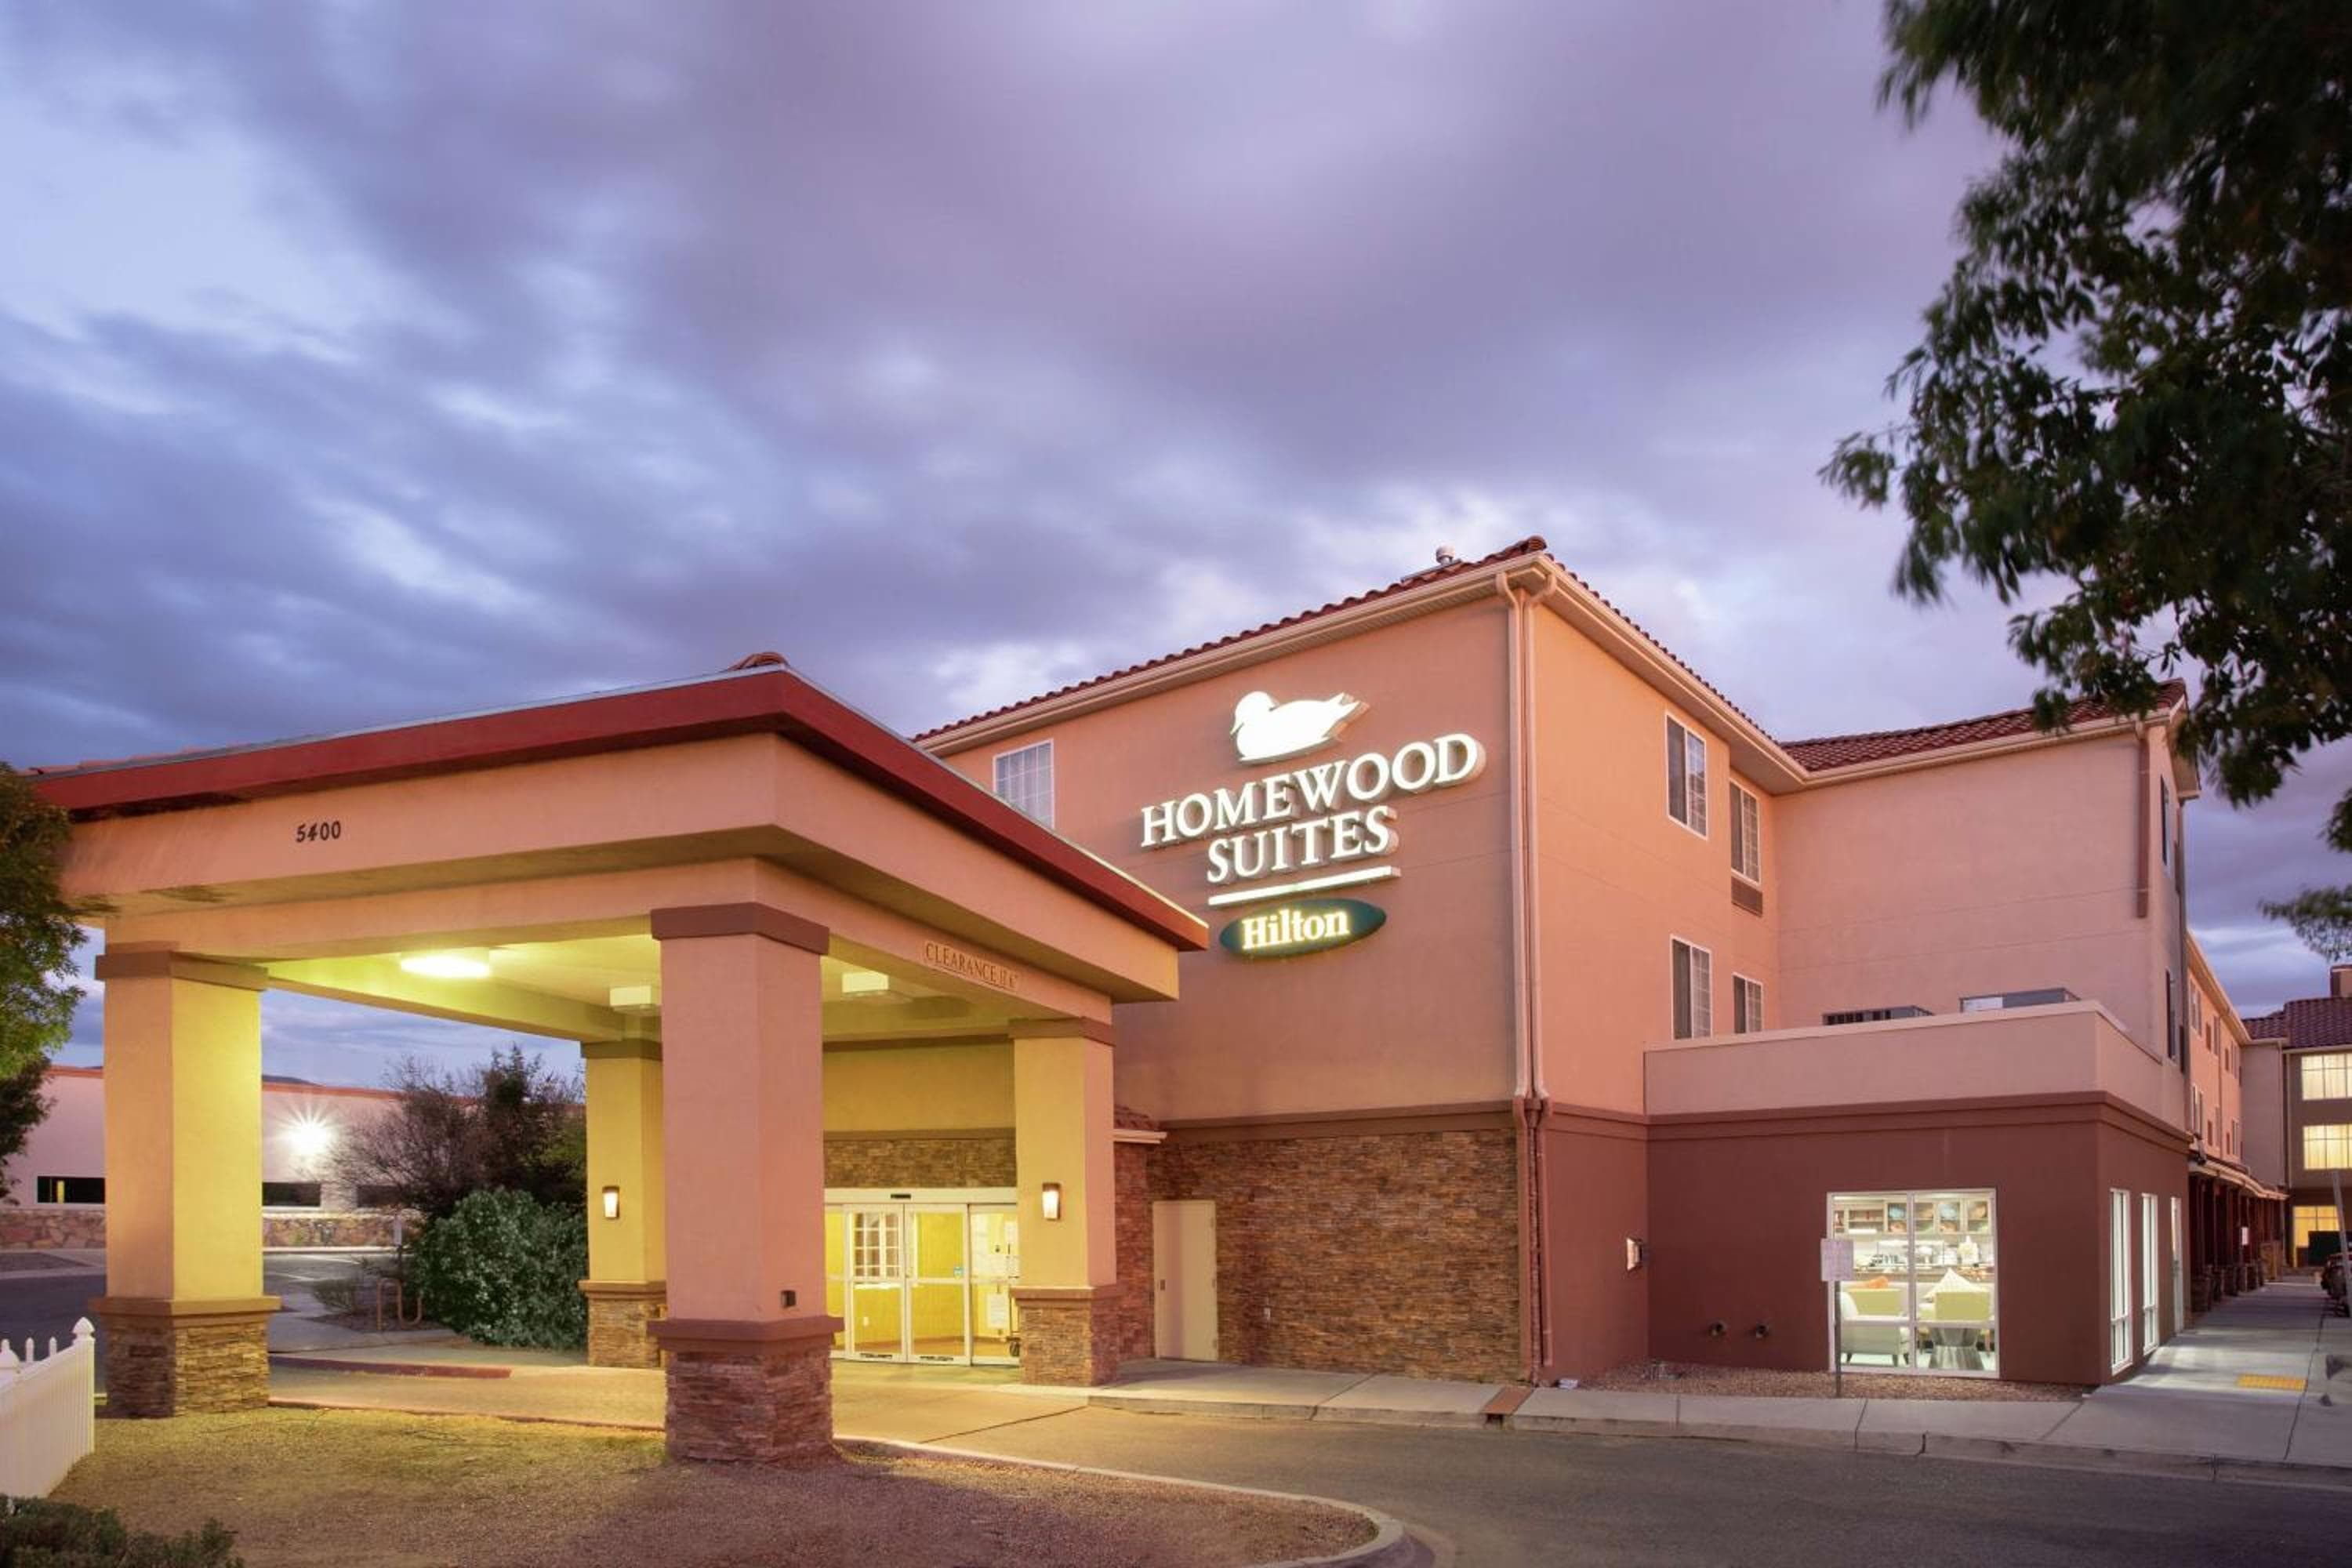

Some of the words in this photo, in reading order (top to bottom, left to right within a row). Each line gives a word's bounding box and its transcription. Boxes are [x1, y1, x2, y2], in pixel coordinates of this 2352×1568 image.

[1141, 732, 1484, 848] HOMEWOOD
[296, 820, 341, 843] 5400
[1207, 805, 1399, 884] SUITES
[1241, 908, 1350, 951] Hilton
[925, 942, 996, 983] CLEARANCE
